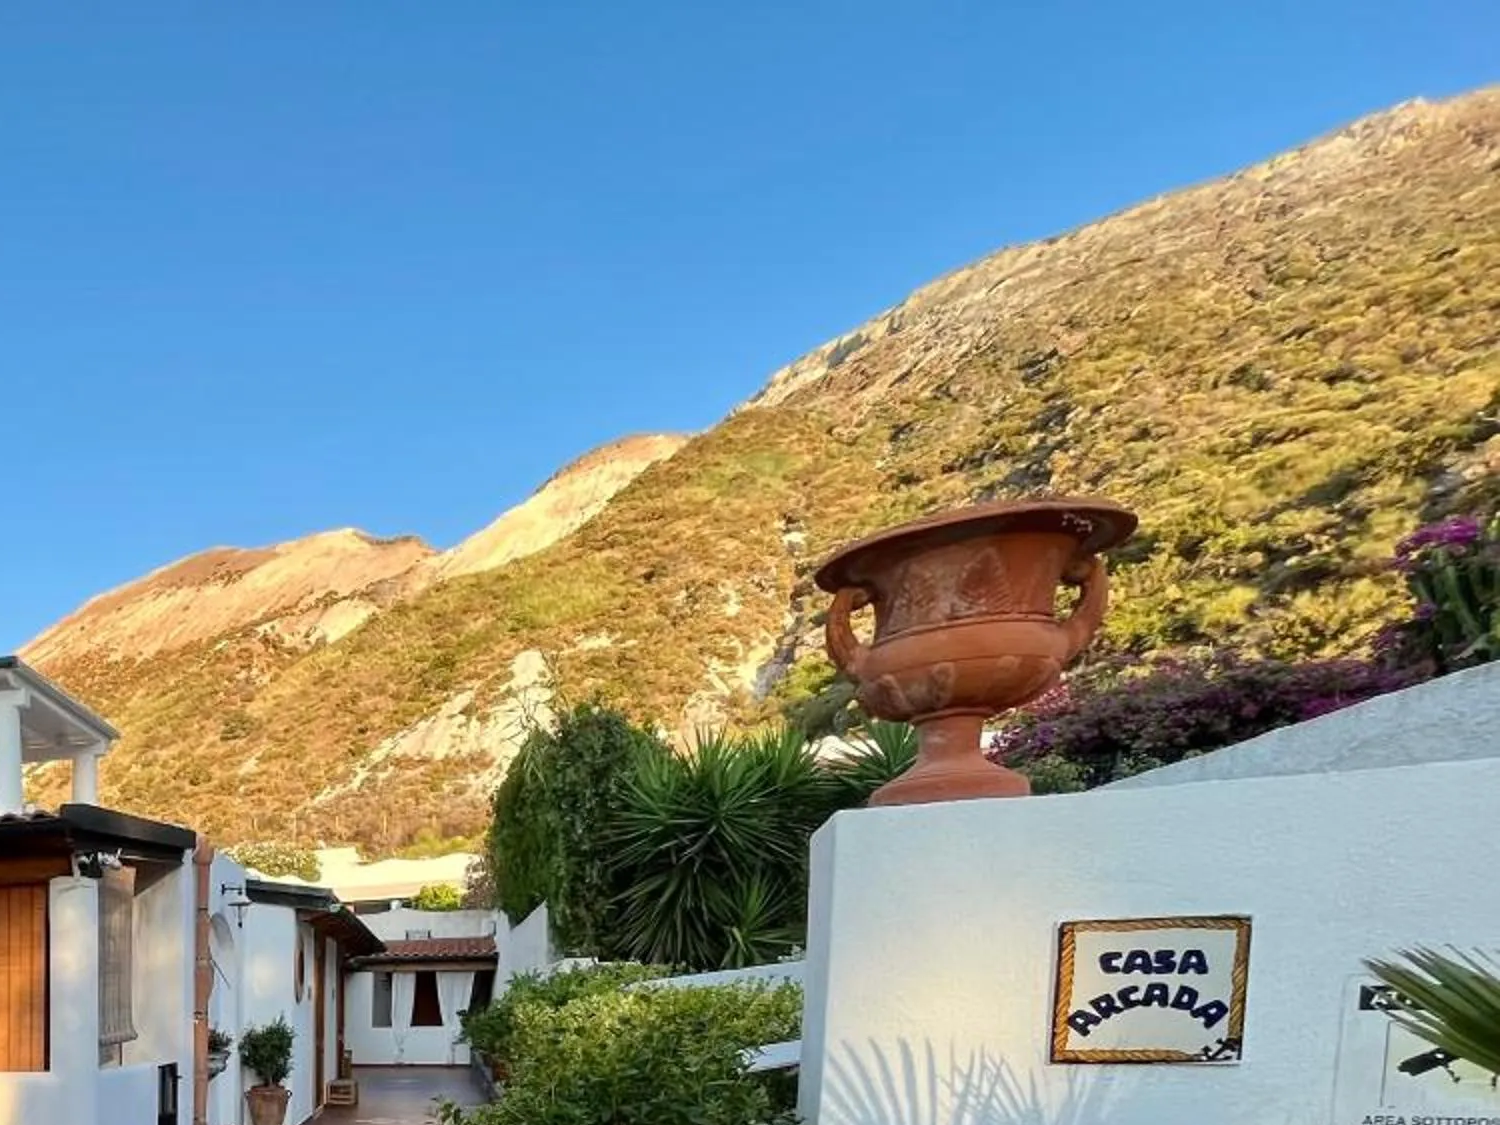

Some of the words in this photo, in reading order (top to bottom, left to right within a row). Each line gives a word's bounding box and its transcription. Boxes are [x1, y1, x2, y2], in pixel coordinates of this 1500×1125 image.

[1098, 949, 1209, 975] CASA
[1068, 982, 1229, 1037] ARCADA
[1361, 1115, 1406, 1125] AREA
